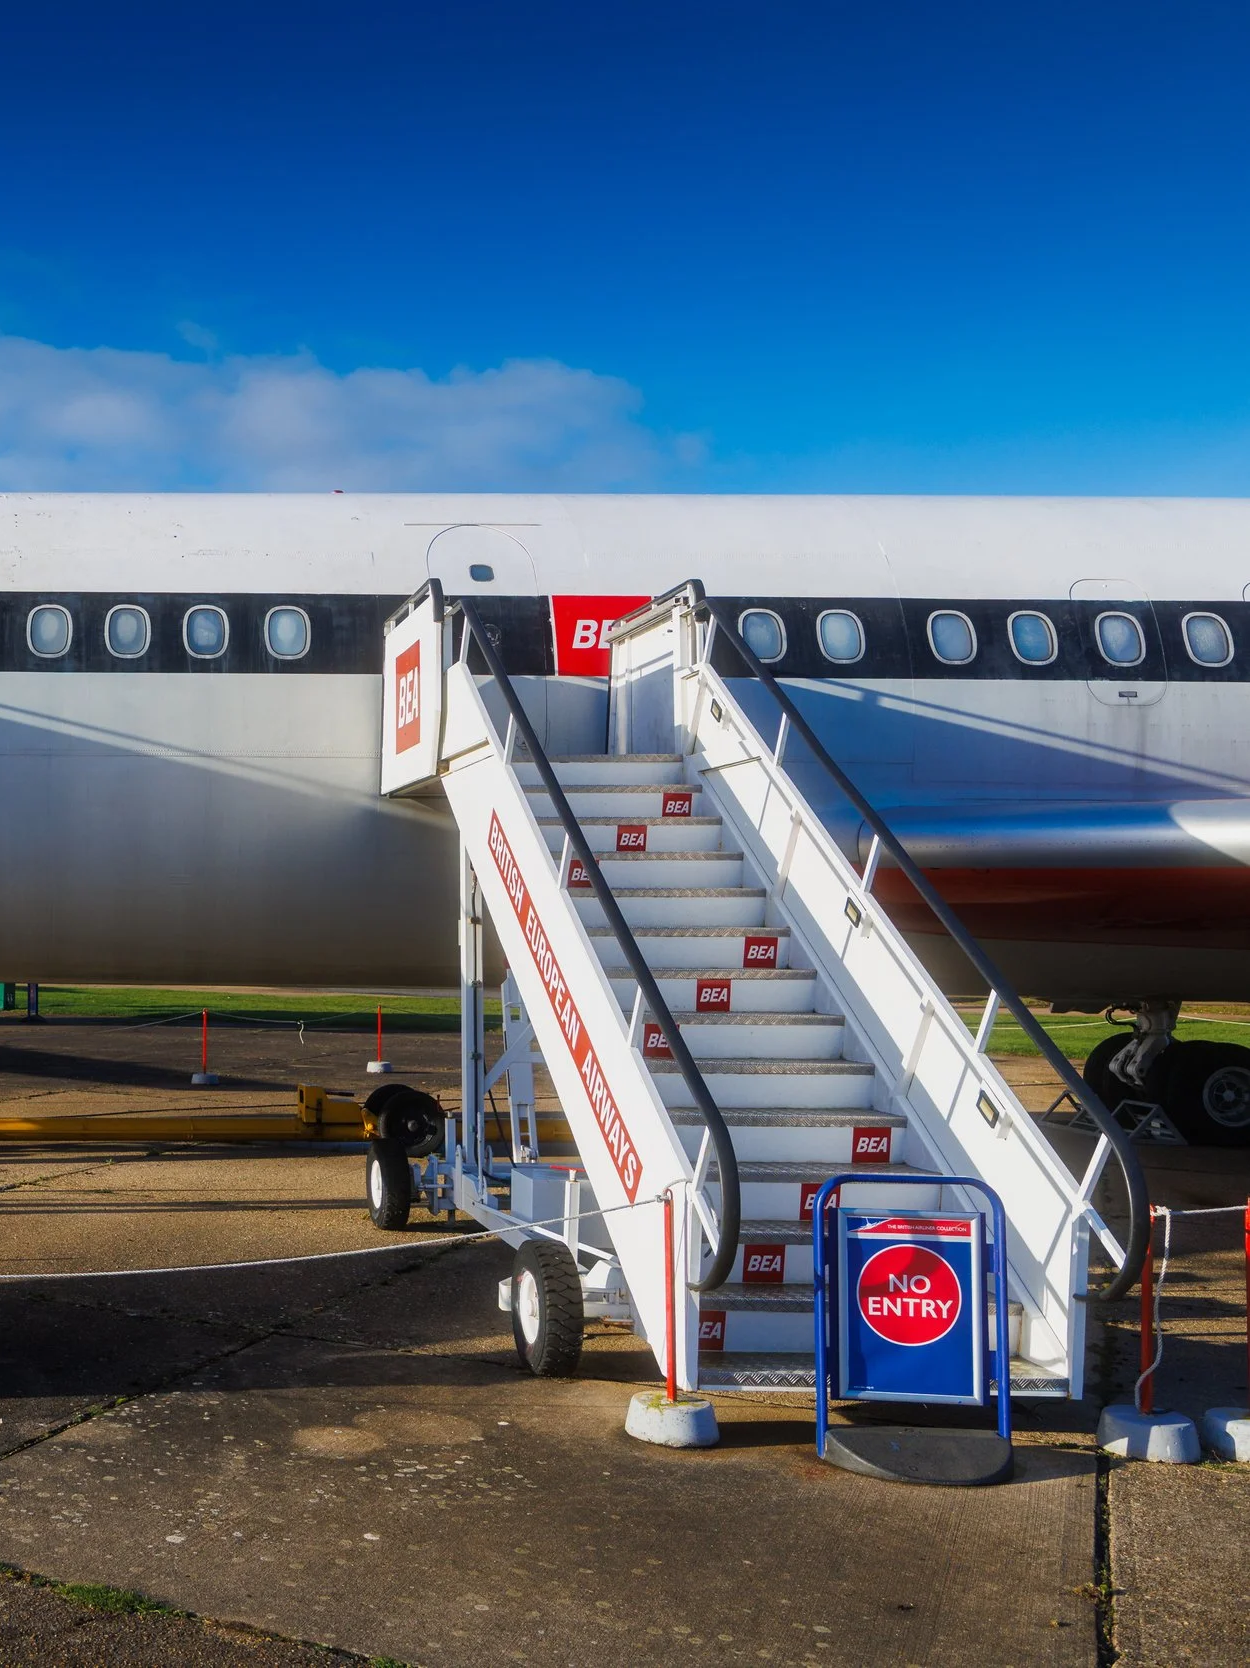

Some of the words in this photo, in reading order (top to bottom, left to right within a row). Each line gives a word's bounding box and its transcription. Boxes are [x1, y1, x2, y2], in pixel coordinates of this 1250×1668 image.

[572, 619, 615, 649] BE
[398, 667, 419, 729] BEA
[665, 801, 690, 813] BEA
[620, 834, 645, 846] BEA
[571, 868, 590, 881] BE
[747, 946, 775, 959] BEA
[700, 989, 728, 1002] BEA
[491, 821, 524, 915] BRITISH
[524, 912, 581, 1051] EUROPEAN
[581, 1053, 635, 1191] AIRWAYS
[647, 1033, 669, 1048] BE
[856, 1137, 887, 1153] BEA
[804, 1193, 837, 1209] BA
[747, 1255, 781, 1272] BEA
[888, 1273, 931, 1295] NO
[867, 1297, 953, 1320] ENTRY
[699, 1321, 722, 1339] EA
